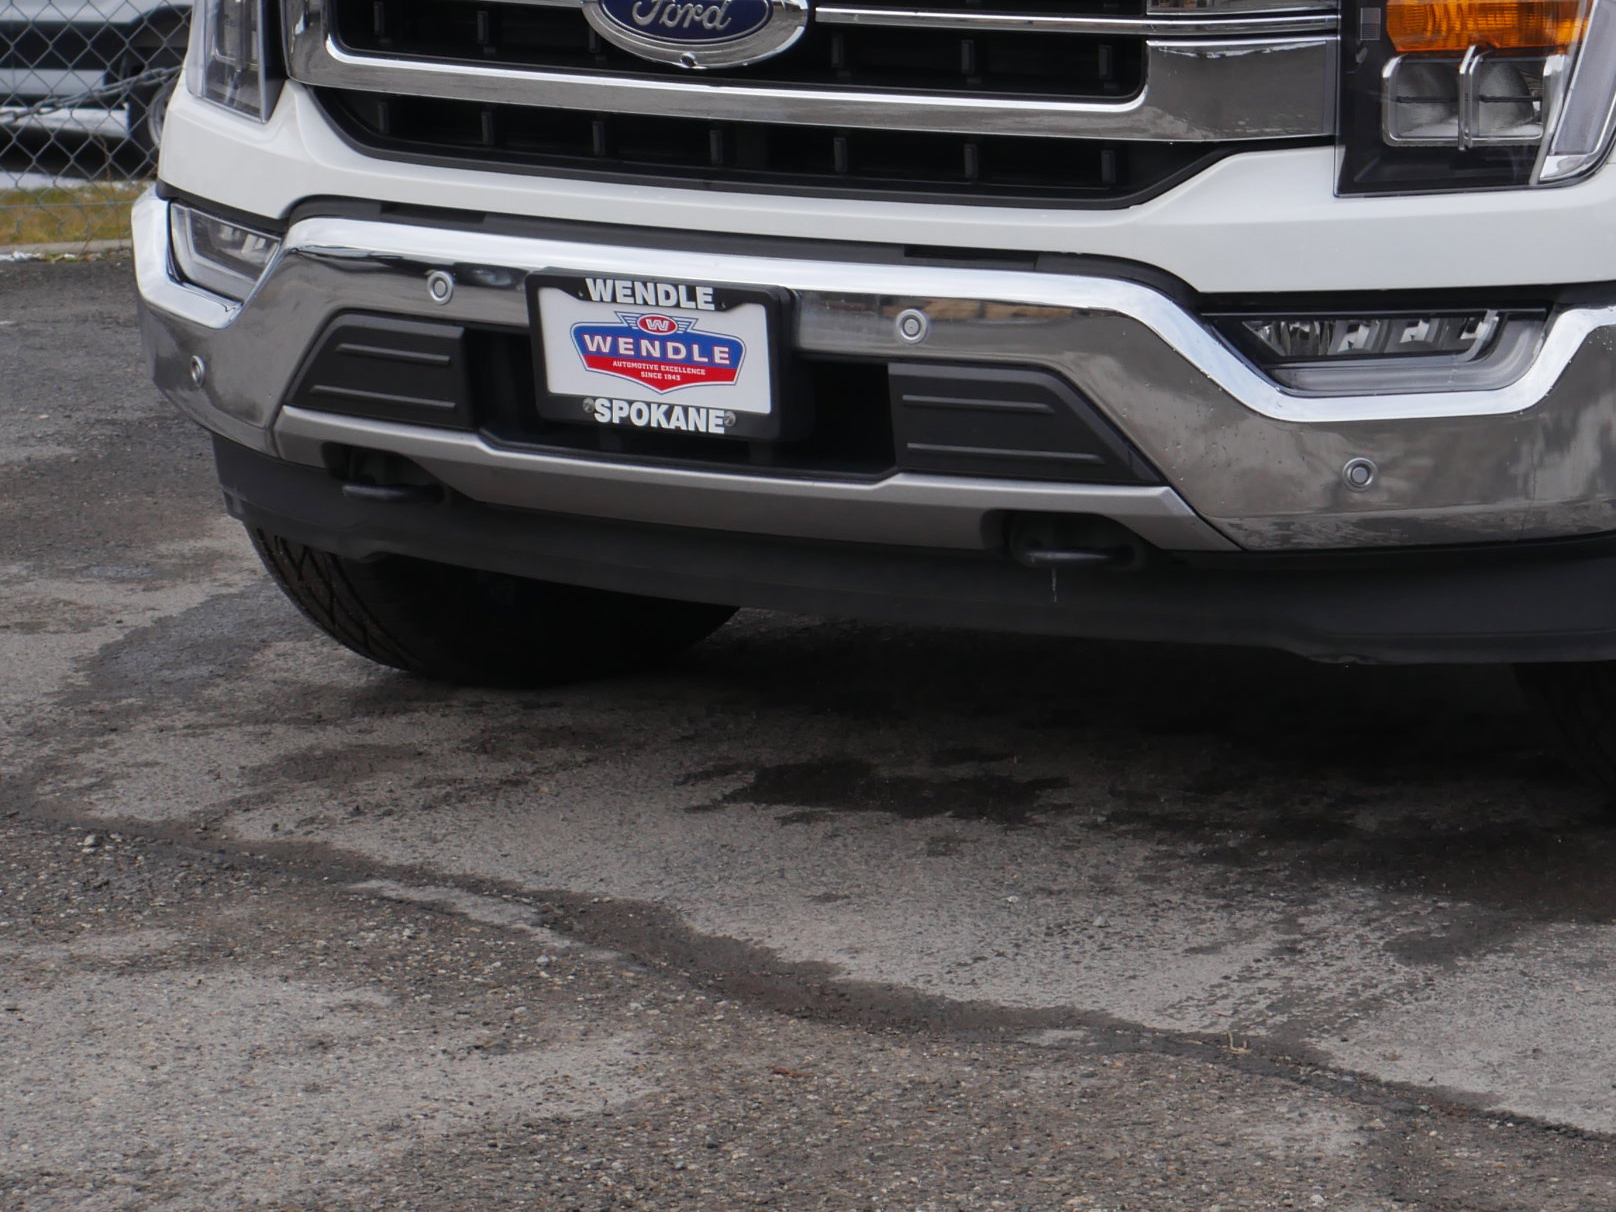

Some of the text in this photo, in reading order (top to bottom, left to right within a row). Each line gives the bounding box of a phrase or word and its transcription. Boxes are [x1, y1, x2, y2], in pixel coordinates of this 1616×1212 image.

[585, 277, 716, 311] WENDLE
[583, 334, 730, 365] WENDLE
[612, 360, 706, 376] AUTOMOTIVE EXCELLENCE
[641, 371, 663, 380] SINCE
[594, 398, 725, 434] SPOKANE
